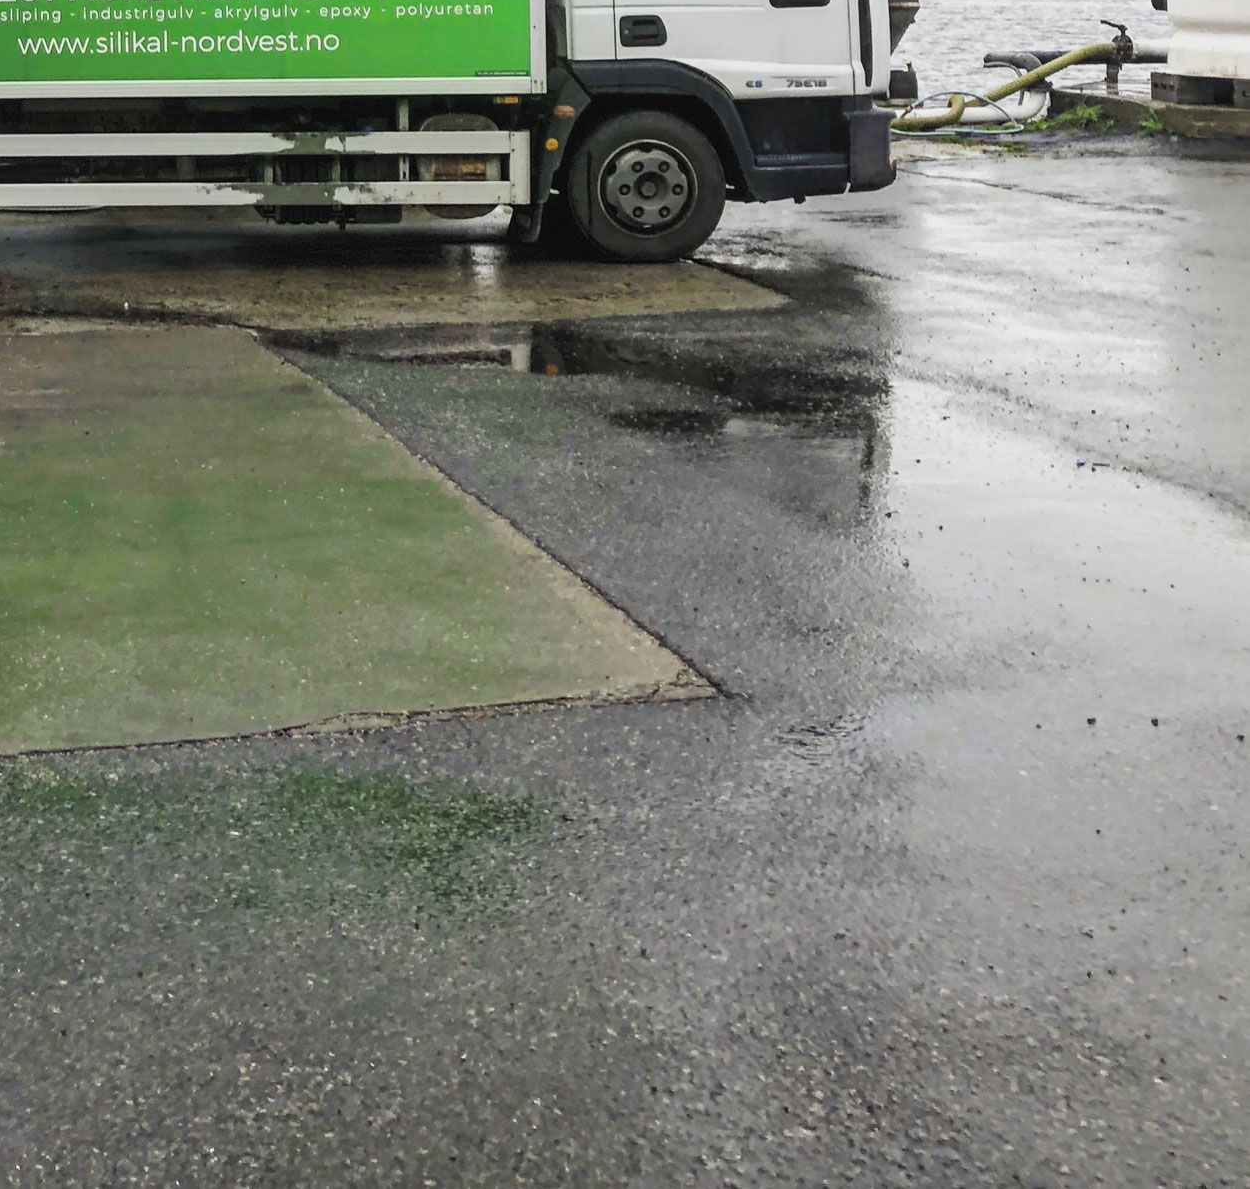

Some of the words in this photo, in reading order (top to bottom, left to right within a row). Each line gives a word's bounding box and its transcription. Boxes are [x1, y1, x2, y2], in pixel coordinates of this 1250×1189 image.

[83, 6, 194, 22] industrigulv
[214, 4, 298, 21] akrylgulv
[319, 6, 371, 20] epoxy
[396, 2, 494, 19] polyuretan
[17, 29, 340, 55] www.silikal-nordvest.no
